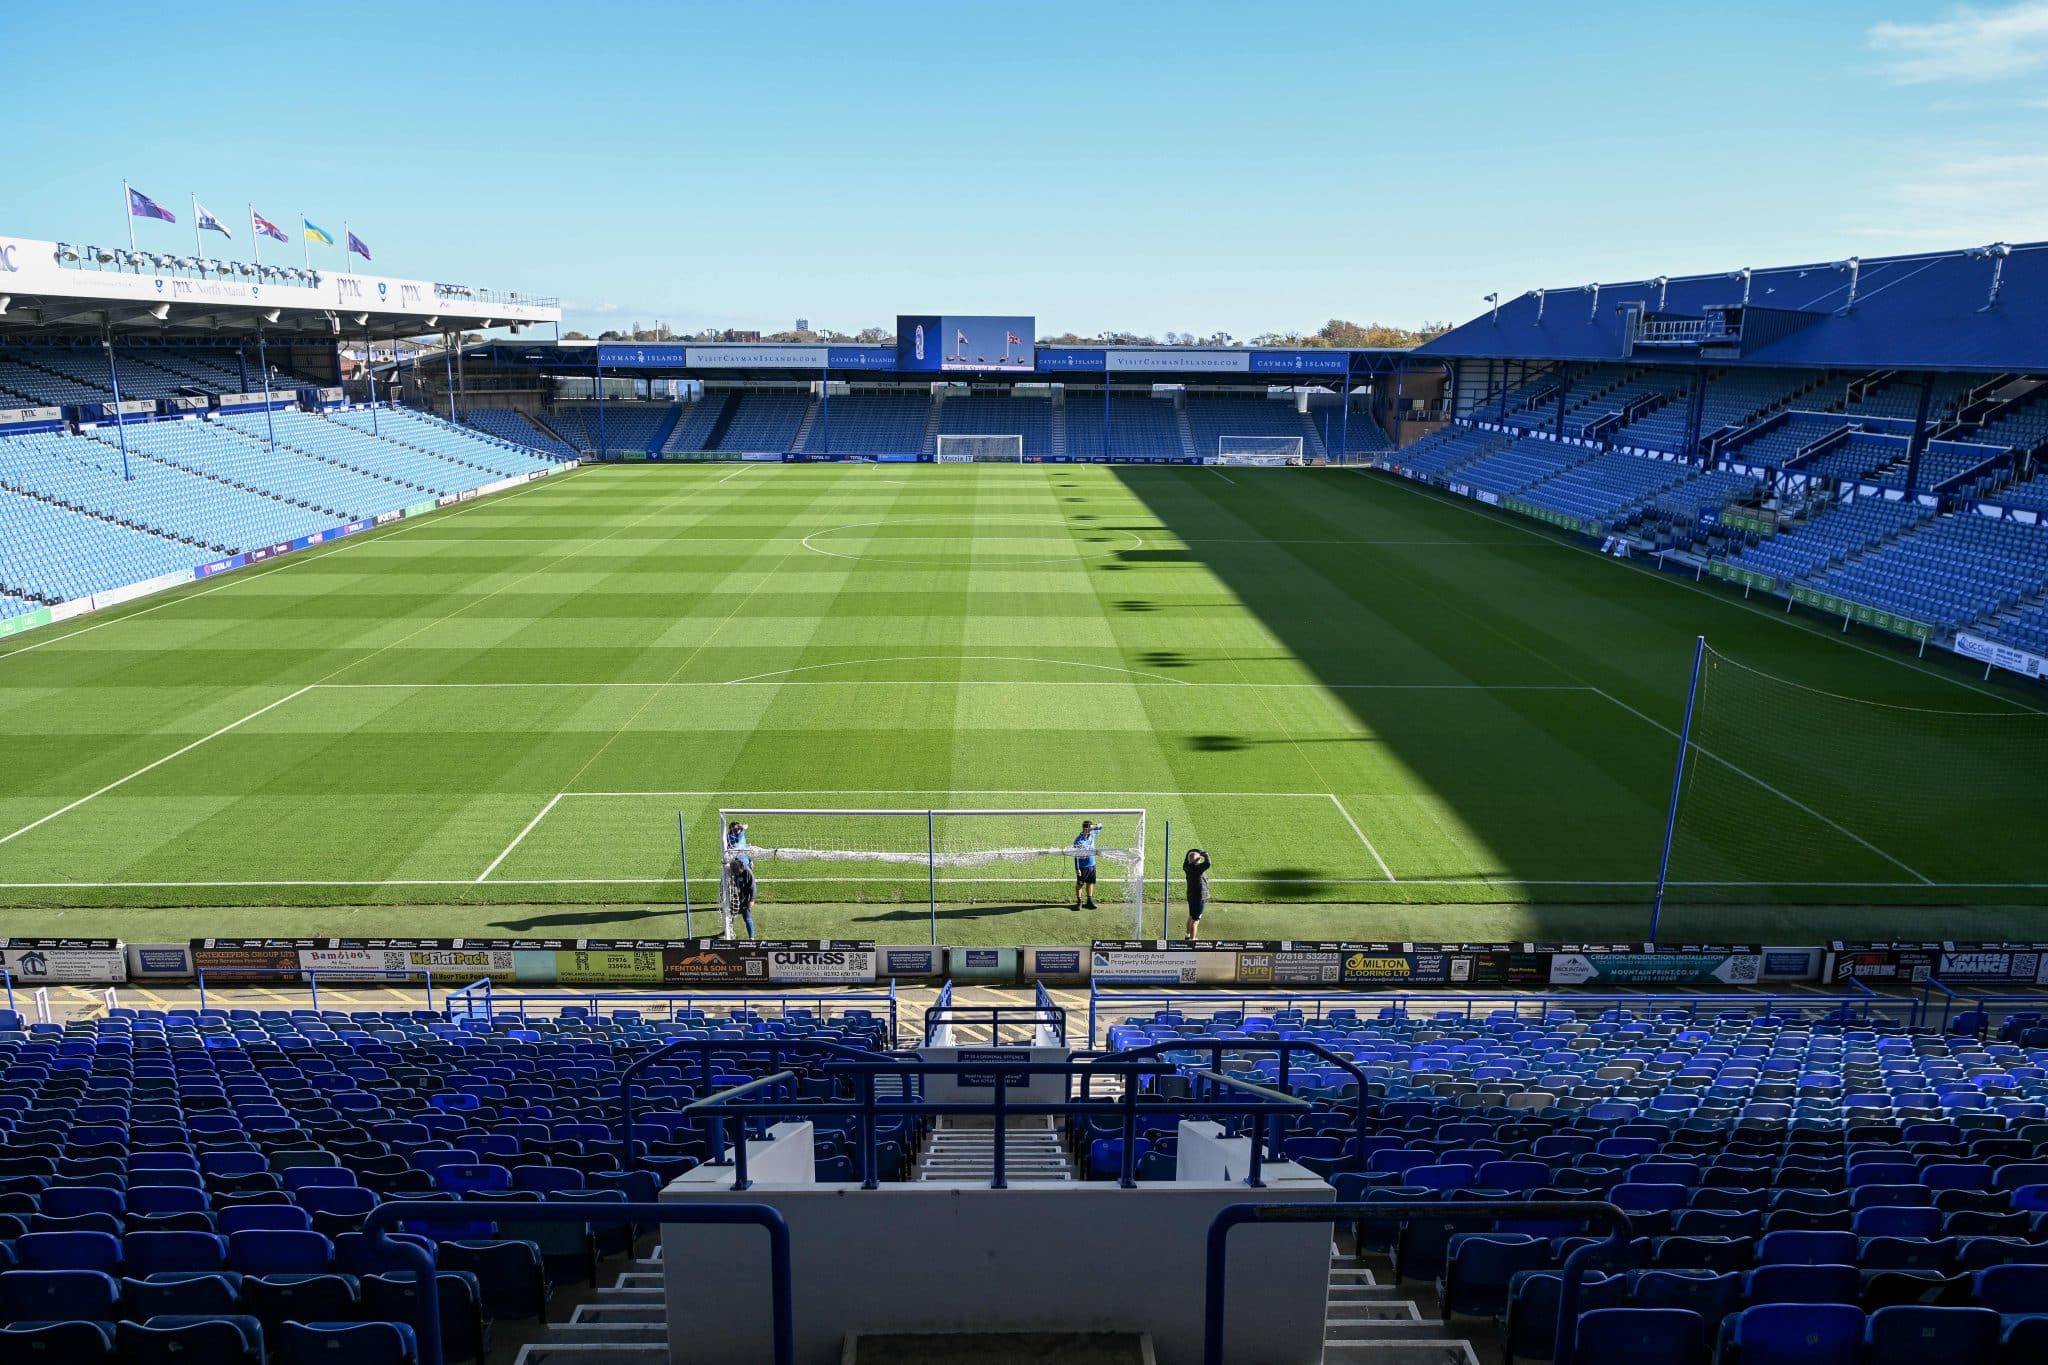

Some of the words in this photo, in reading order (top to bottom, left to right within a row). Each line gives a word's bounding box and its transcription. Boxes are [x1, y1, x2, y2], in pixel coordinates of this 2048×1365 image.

[1257, 360, 1293, 368] CAYMAN
[1305, 360, 1341, 368] ISLANDS
[311, 951, 371, 961] Bambino's
[411, 952, 489, 965] WeFlatPack
[1242, 957, 1269, 966] build
[1363, 960, 1404, 968] MILTON
[1241, 967, 1269, 975] sure
[1956, 962, 2009, 973] DANCE
